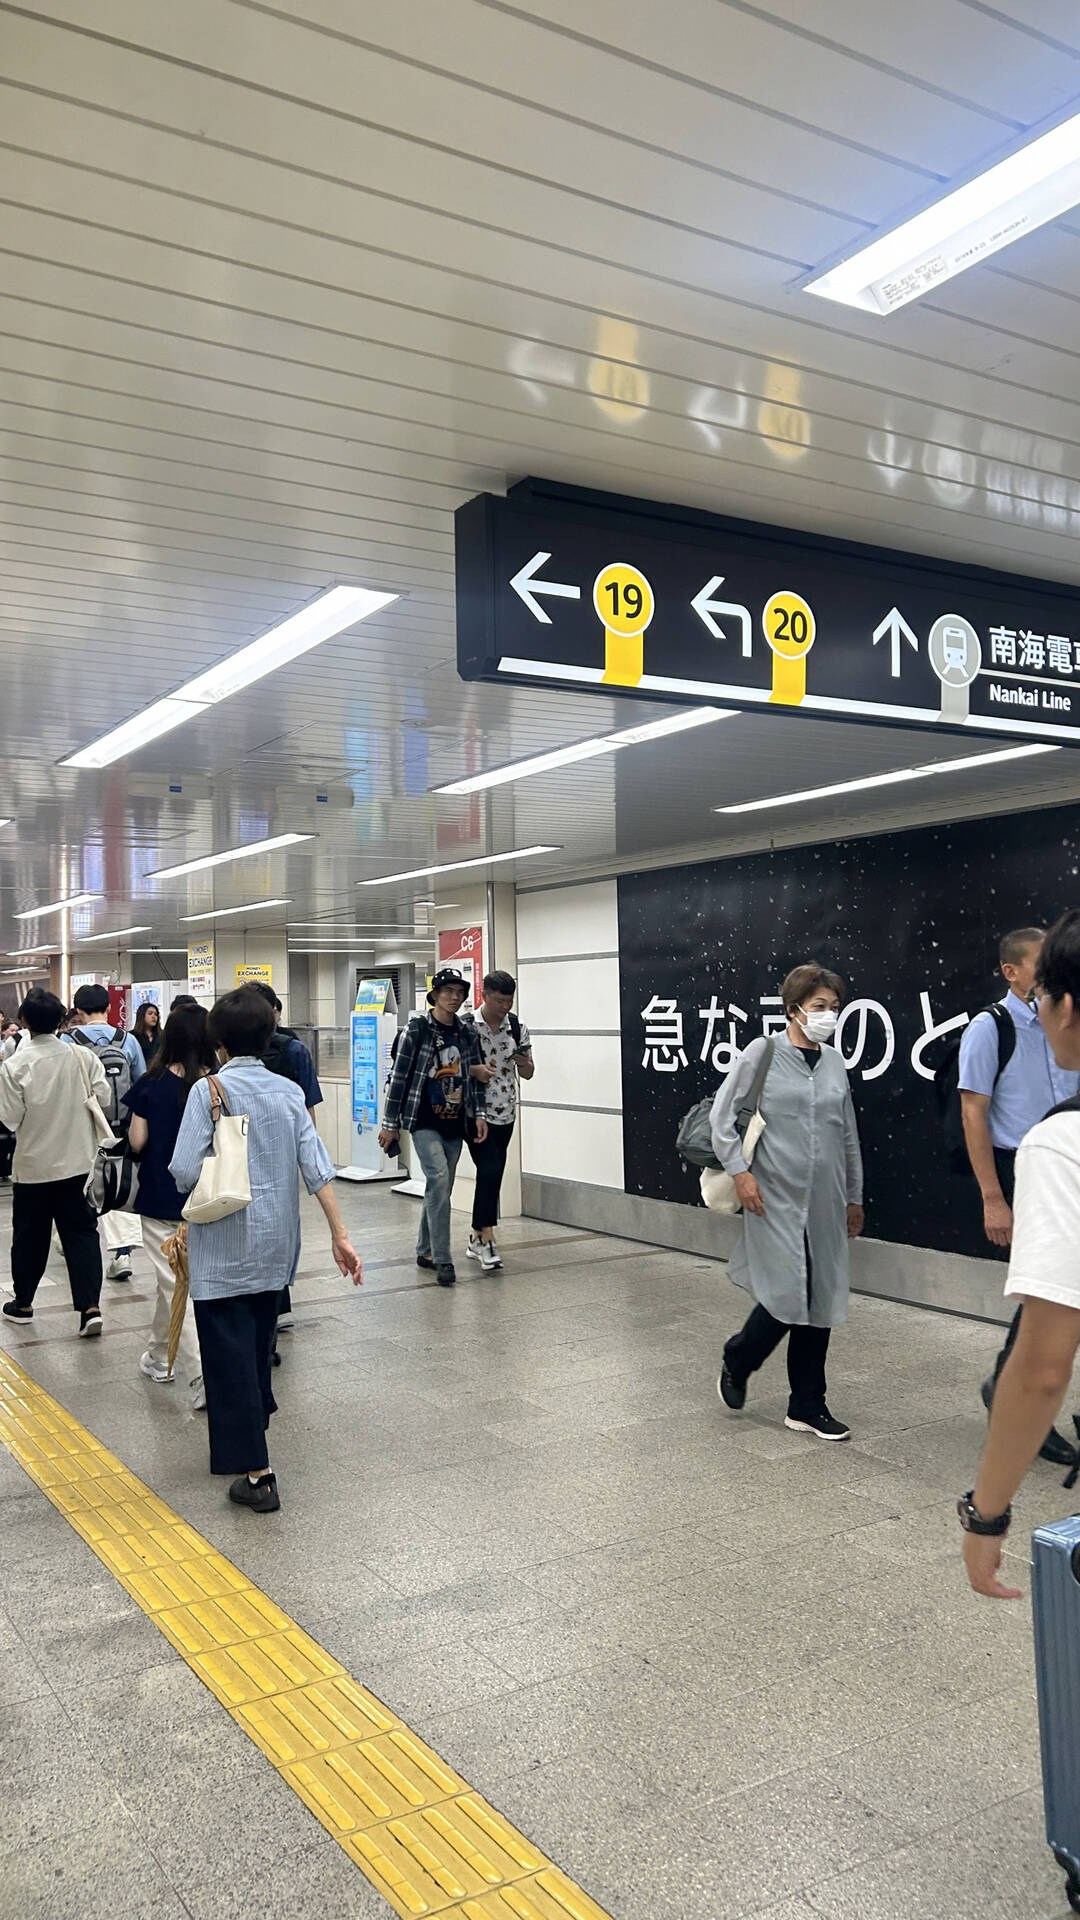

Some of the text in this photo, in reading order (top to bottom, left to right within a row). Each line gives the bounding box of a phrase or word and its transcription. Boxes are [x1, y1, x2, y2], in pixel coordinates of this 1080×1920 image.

[604, 581, 643, 619] 19
[773, 607, 808, 644] 20
[989, 625, 1080, 674] 南海電
[989, 683, 1072, 711] Nankai Line
[460, 935, 474, 952] C6
[189, 956, 213, 968] EXCHANGE
